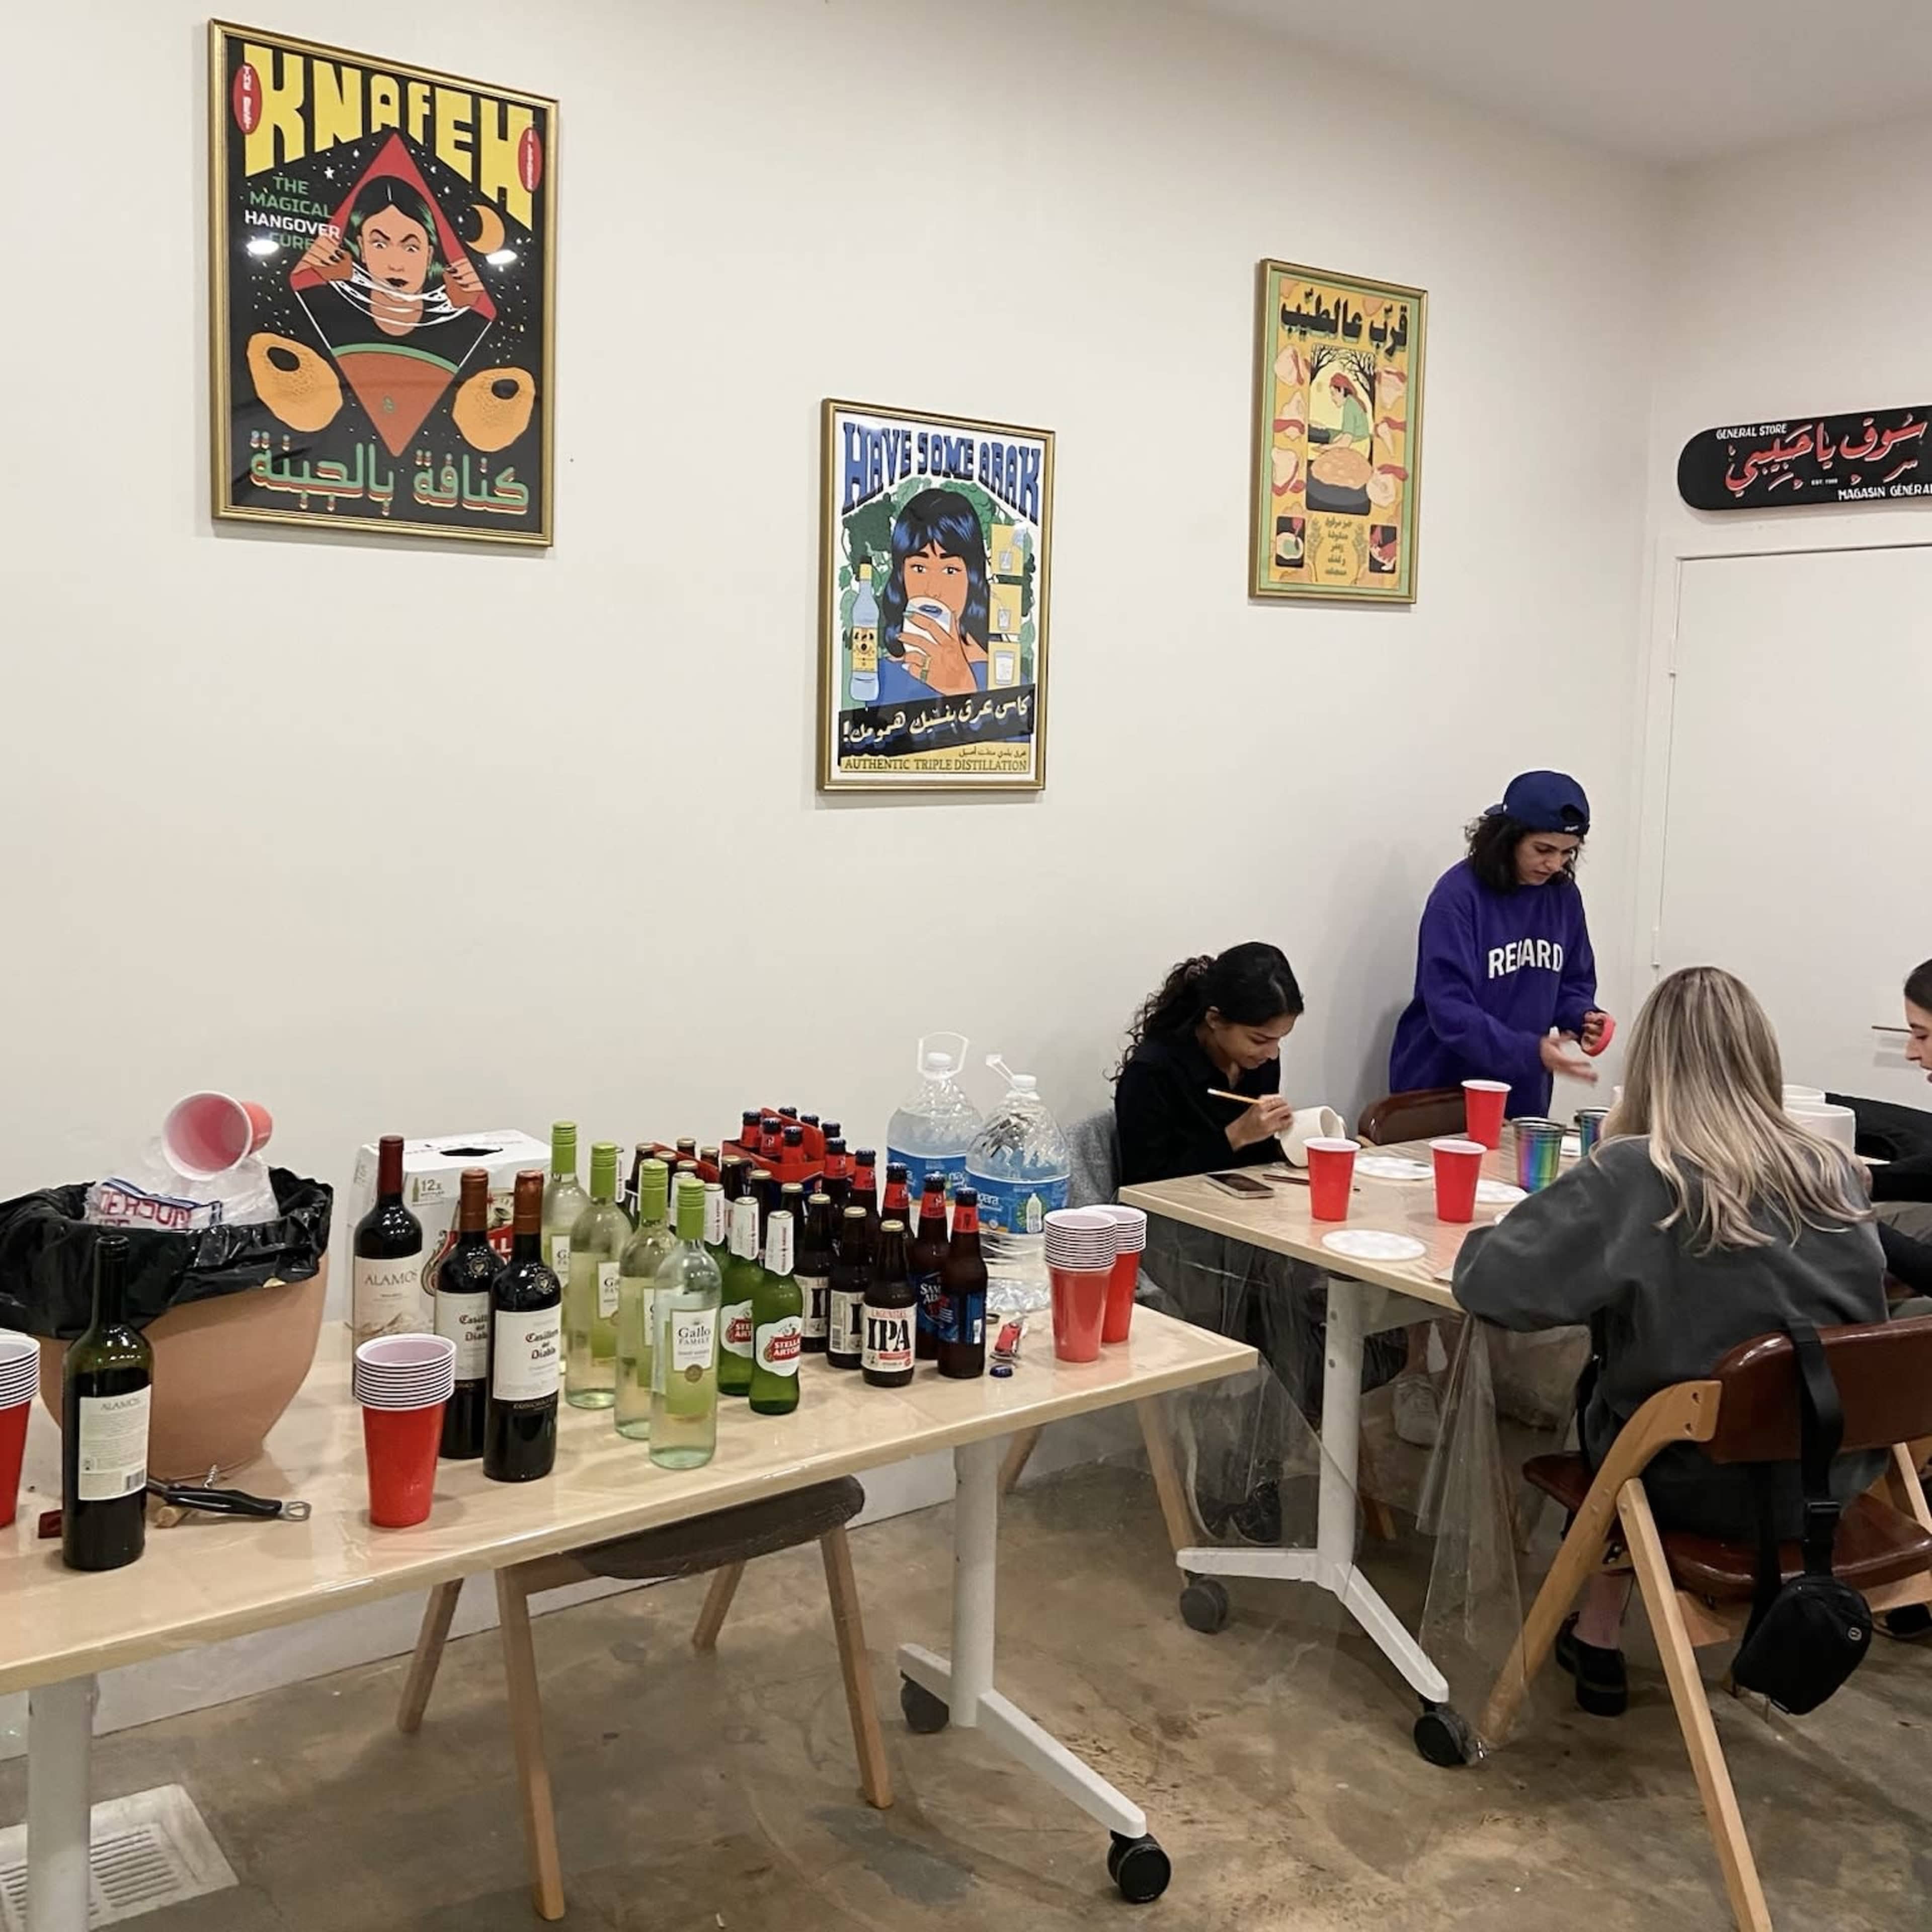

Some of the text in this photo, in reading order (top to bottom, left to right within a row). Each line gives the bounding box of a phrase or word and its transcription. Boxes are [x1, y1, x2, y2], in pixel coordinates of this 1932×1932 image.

[244, 43, 533, 232] KNAFEH
[272, 176, 310, 195] THE
[250, 190, 333, 218] MAGICAL
[245, 209, 341, 239] HANGOVER
[1716, 423, 1788, 440] GENERAL STORE
[251, 430, 529, 517] كنافة بالجبنة
[842, 422, 1041, 526] HAVE SOME ARAK
[1837, 486, 1886, 501] MAGASIN
[958, 698, 994, 725] عرق
[845, 758, 1027, 771] AUTHENTIC TRIPLE DISTILLATION
[1488, 938, 1564, 979] REARD
[678, 1325, 711, 1338] Gallo
[867, 1318, 911, 1352] IPA
